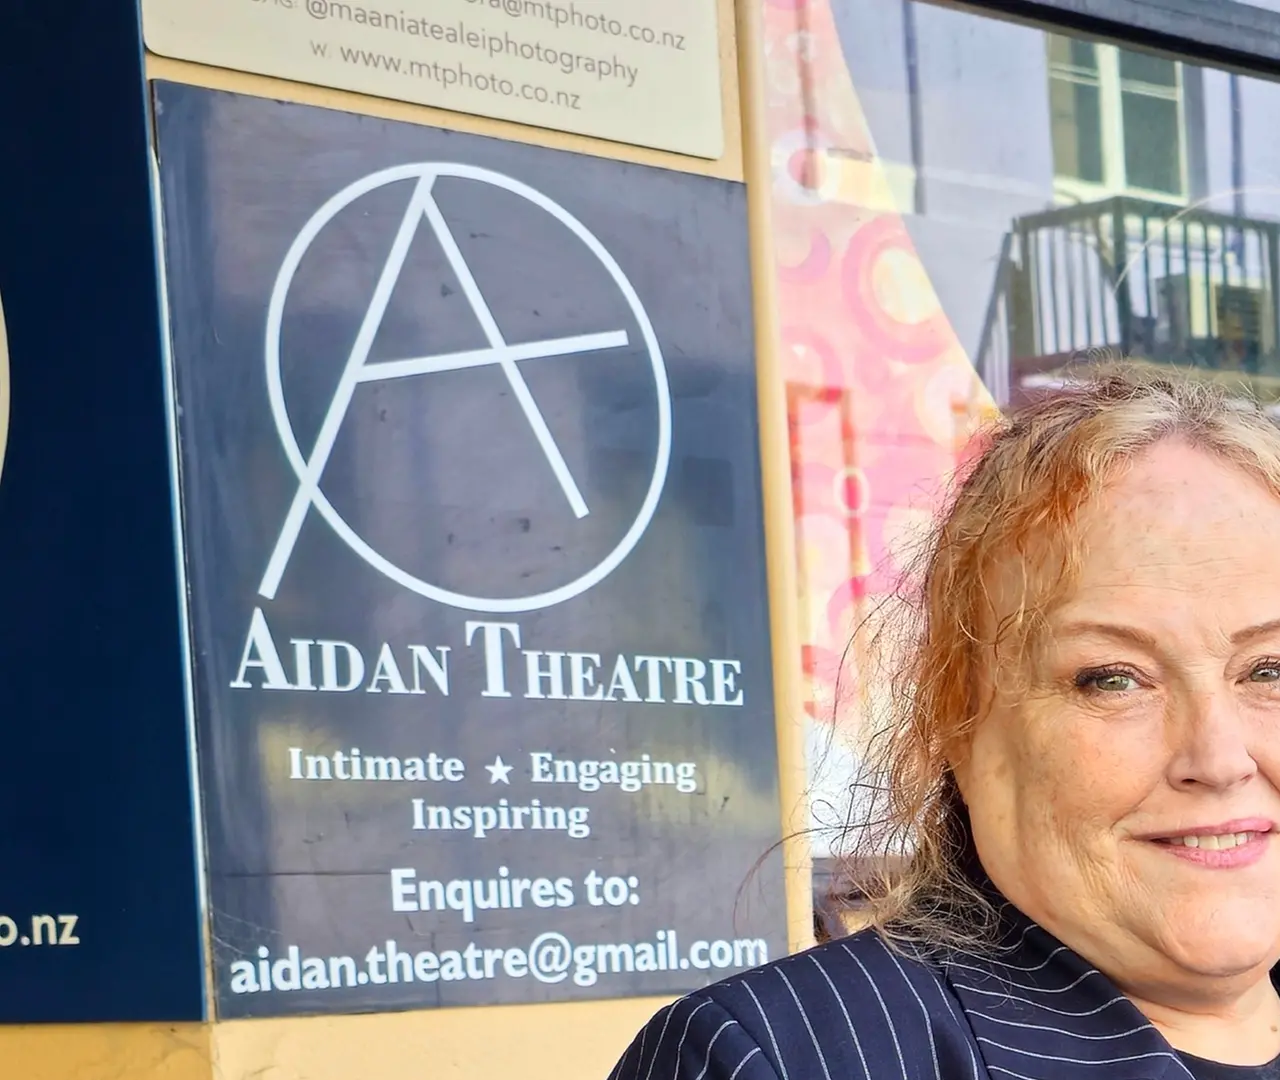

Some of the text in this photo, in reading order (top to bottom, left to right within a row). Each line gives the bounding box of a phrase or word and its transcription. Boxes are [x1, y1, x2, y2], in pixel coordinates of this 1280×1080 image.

[306, 0, 639, 88] @maaniatealeiphotography
[340, 46, 582, 110] www.mtphoto.co.nz
[288, 746, 698, 793] Intimate Engaging
[411, 798, 590, 839] Inspiring
[390, 865, 641, 923] Enquires to:
[230, 930, 769, 995] aidan.theatre@gmail.com
